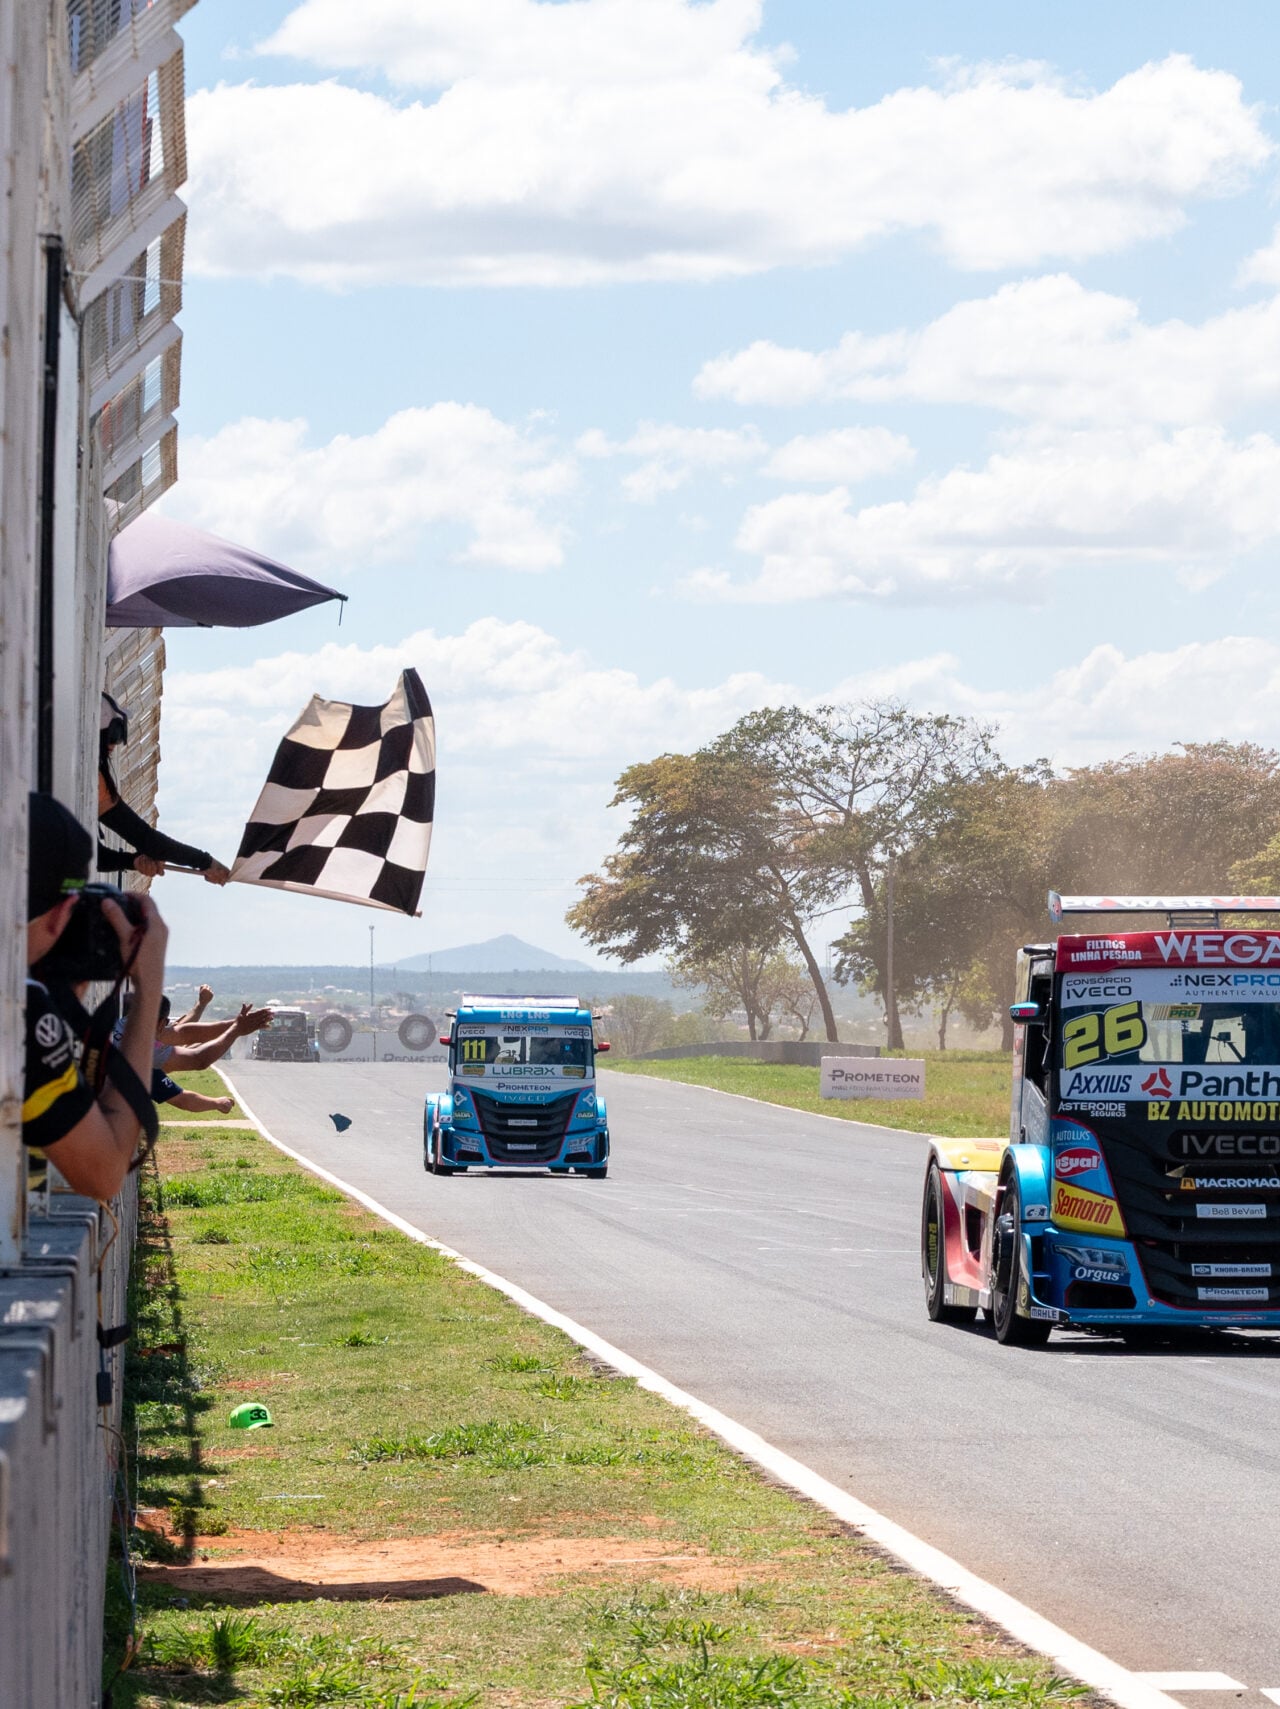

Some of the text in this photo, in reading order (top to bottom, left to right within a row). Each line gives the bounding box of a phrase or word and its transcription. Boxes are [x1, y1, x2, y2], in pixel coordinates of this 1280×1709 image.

[1086, 940, 1126, 950] FILTROS
[1071, 950, 1142, 962] LINHA PESADA
[1066, 976, 1132, 987] CONSÓRCIO
[1066, 986, 1132, 1000] IVECO
[1064, 1001, 1146, 1071] 26
[462, 1039, 486, 1061] 111
[384, 1053, 448, 1062] PROMETEO
[828, 1069, 920, 1083] PROMETEON
[496, 1082, 551, 1091] PROMETEON
[1067, 1073, 1132, 1097] AXXIUS
[1058, 1102, 1126, 1112] ASTEROIDE
[1147, 1101, 1170, 1120] BZ
[1182, 1135, 1280, 1155] IVECO
[1195, 1178, 1280, 1188] MACROMAQ
[1054, 1187, 1114, 1225] Semorin
[1232, 1207, 1264, 1216] BeVant
[1075, 1266, 1120, 1282] Orgus
[1203, 1287, 1265, 1296] PROMETEON
[1031, 1308, 1058, 1319] MAHLE
